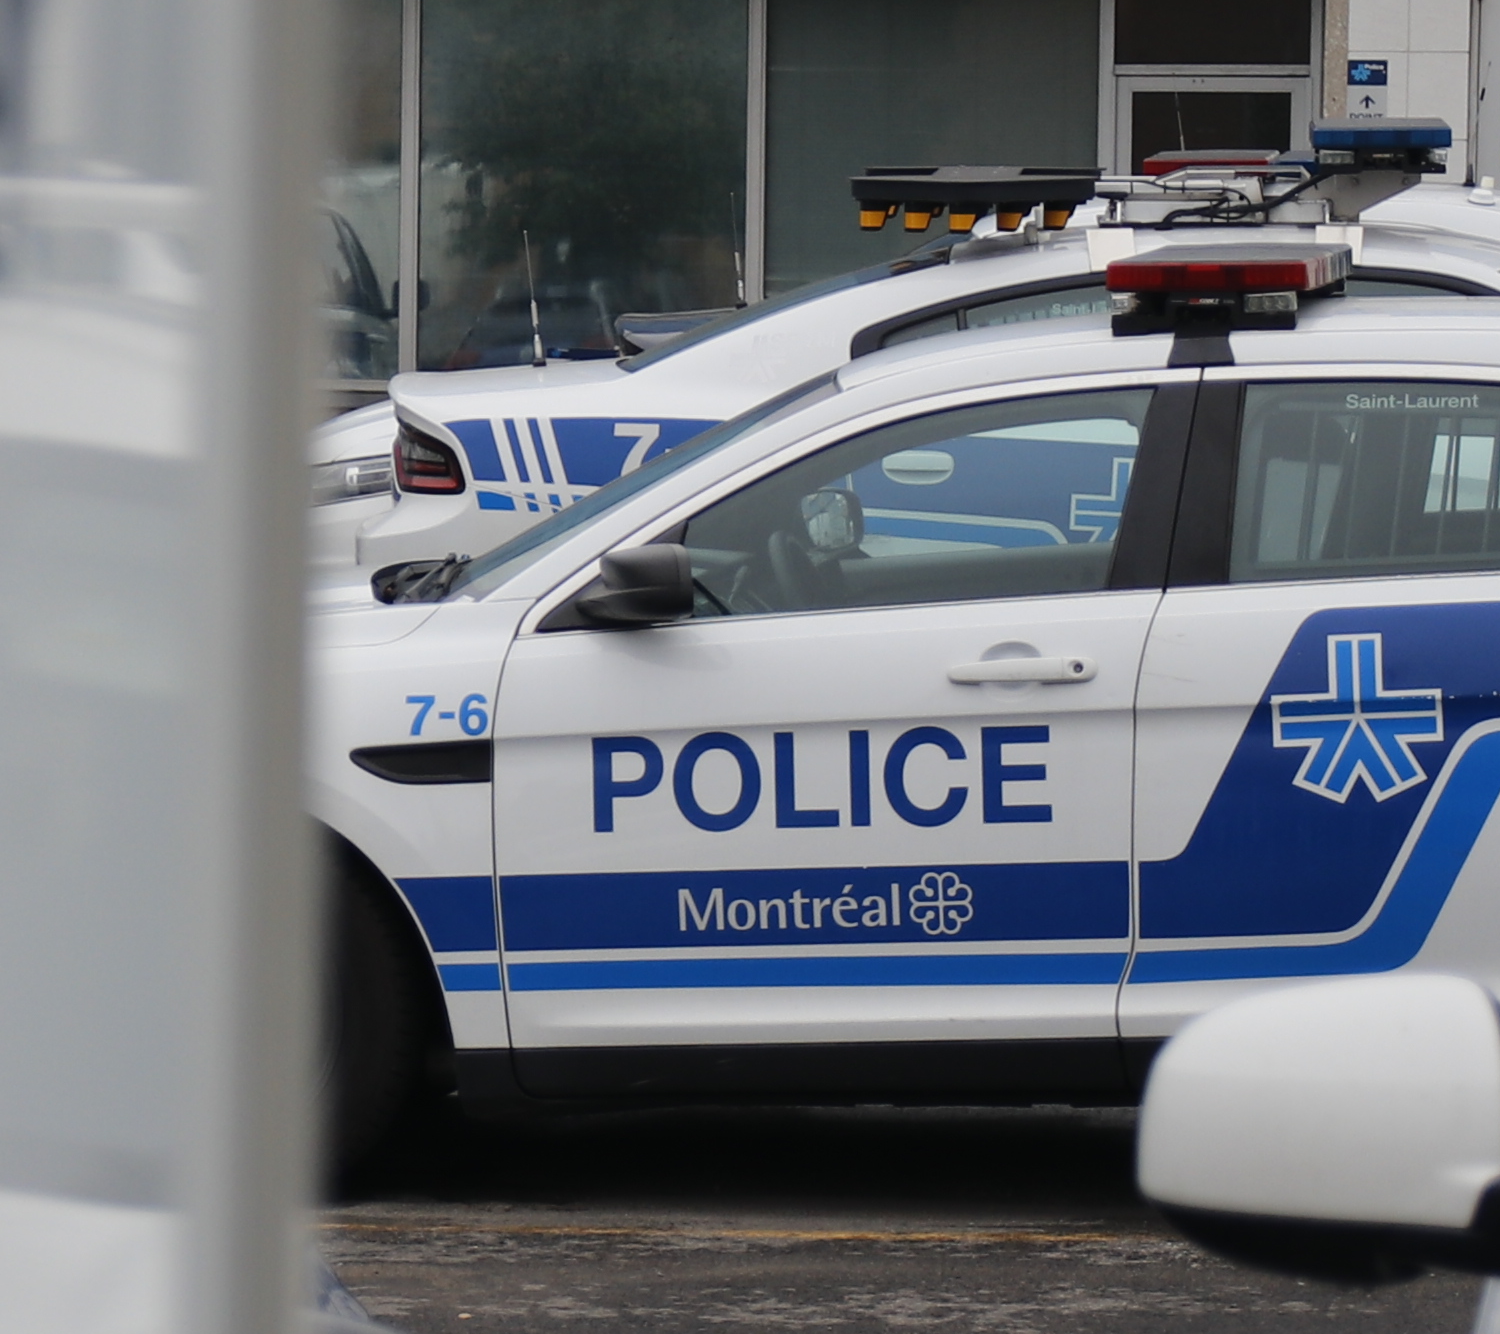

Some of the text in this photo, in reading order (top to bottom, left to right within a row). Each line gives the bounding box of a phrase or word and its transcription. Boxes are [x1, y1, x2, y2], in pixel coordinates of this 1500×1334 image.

[1345, 393, 1479, 410] Saint-Laurent
[405, 692, 489, 738] 7-6
[591, 724, 1053, 833] POLICE
[676, 883, 900, 932] Montréal
